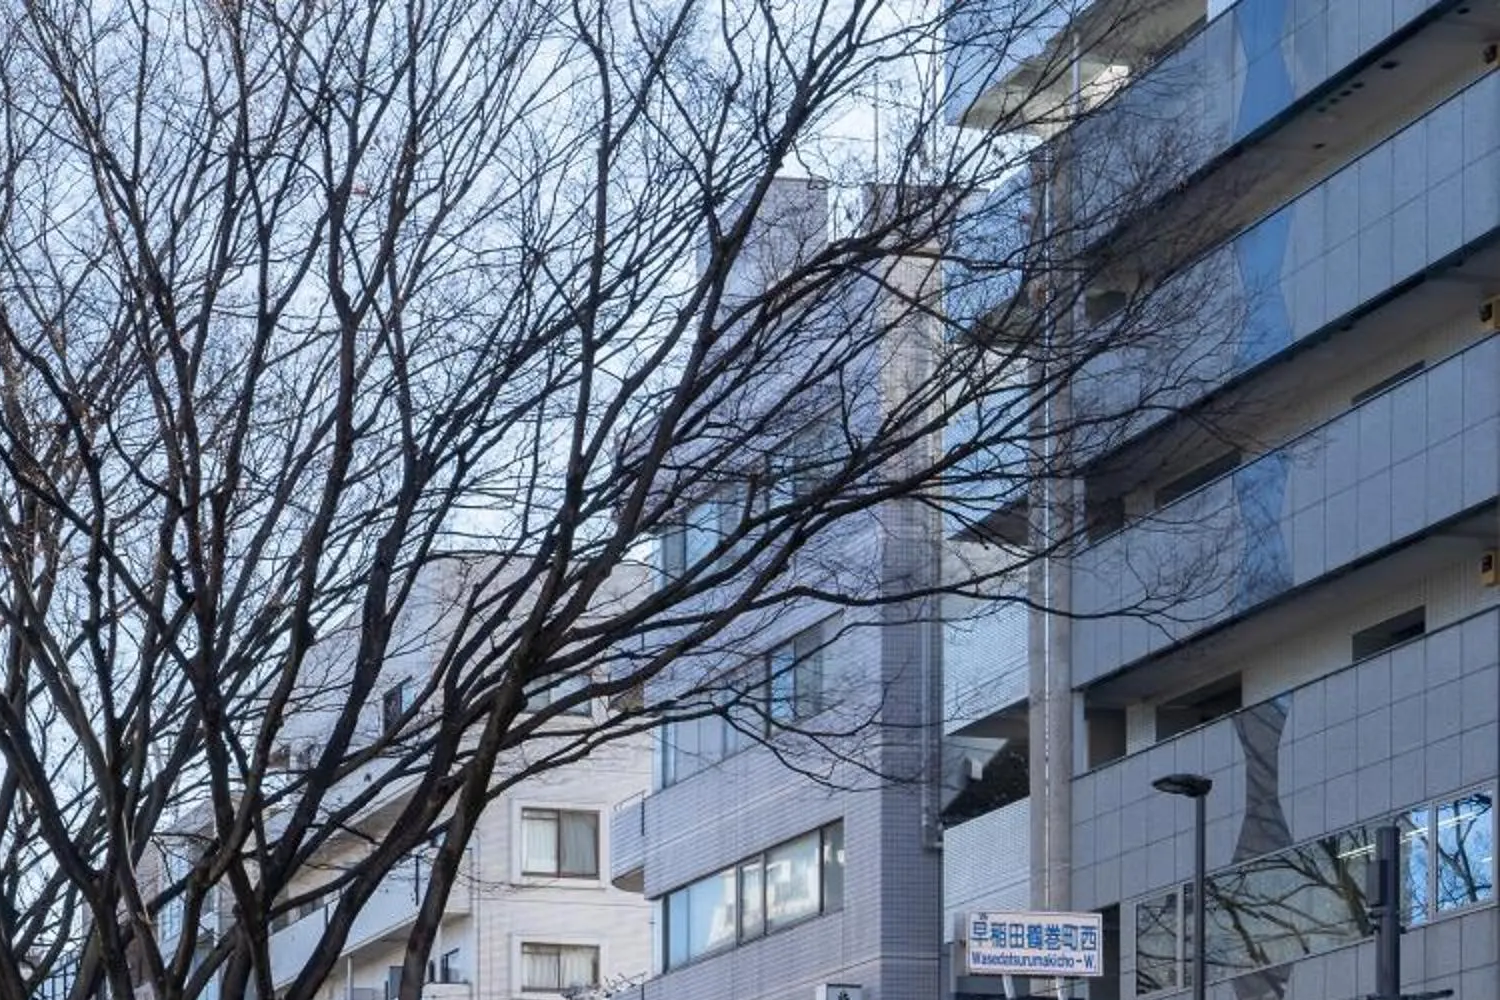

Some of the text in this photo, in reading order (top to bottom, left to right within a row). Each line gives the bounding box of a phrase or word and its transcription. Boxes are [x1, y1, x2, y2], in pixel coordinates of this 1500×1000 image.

[971, 921, 1097, 950] 早稲田鶴巻町西
